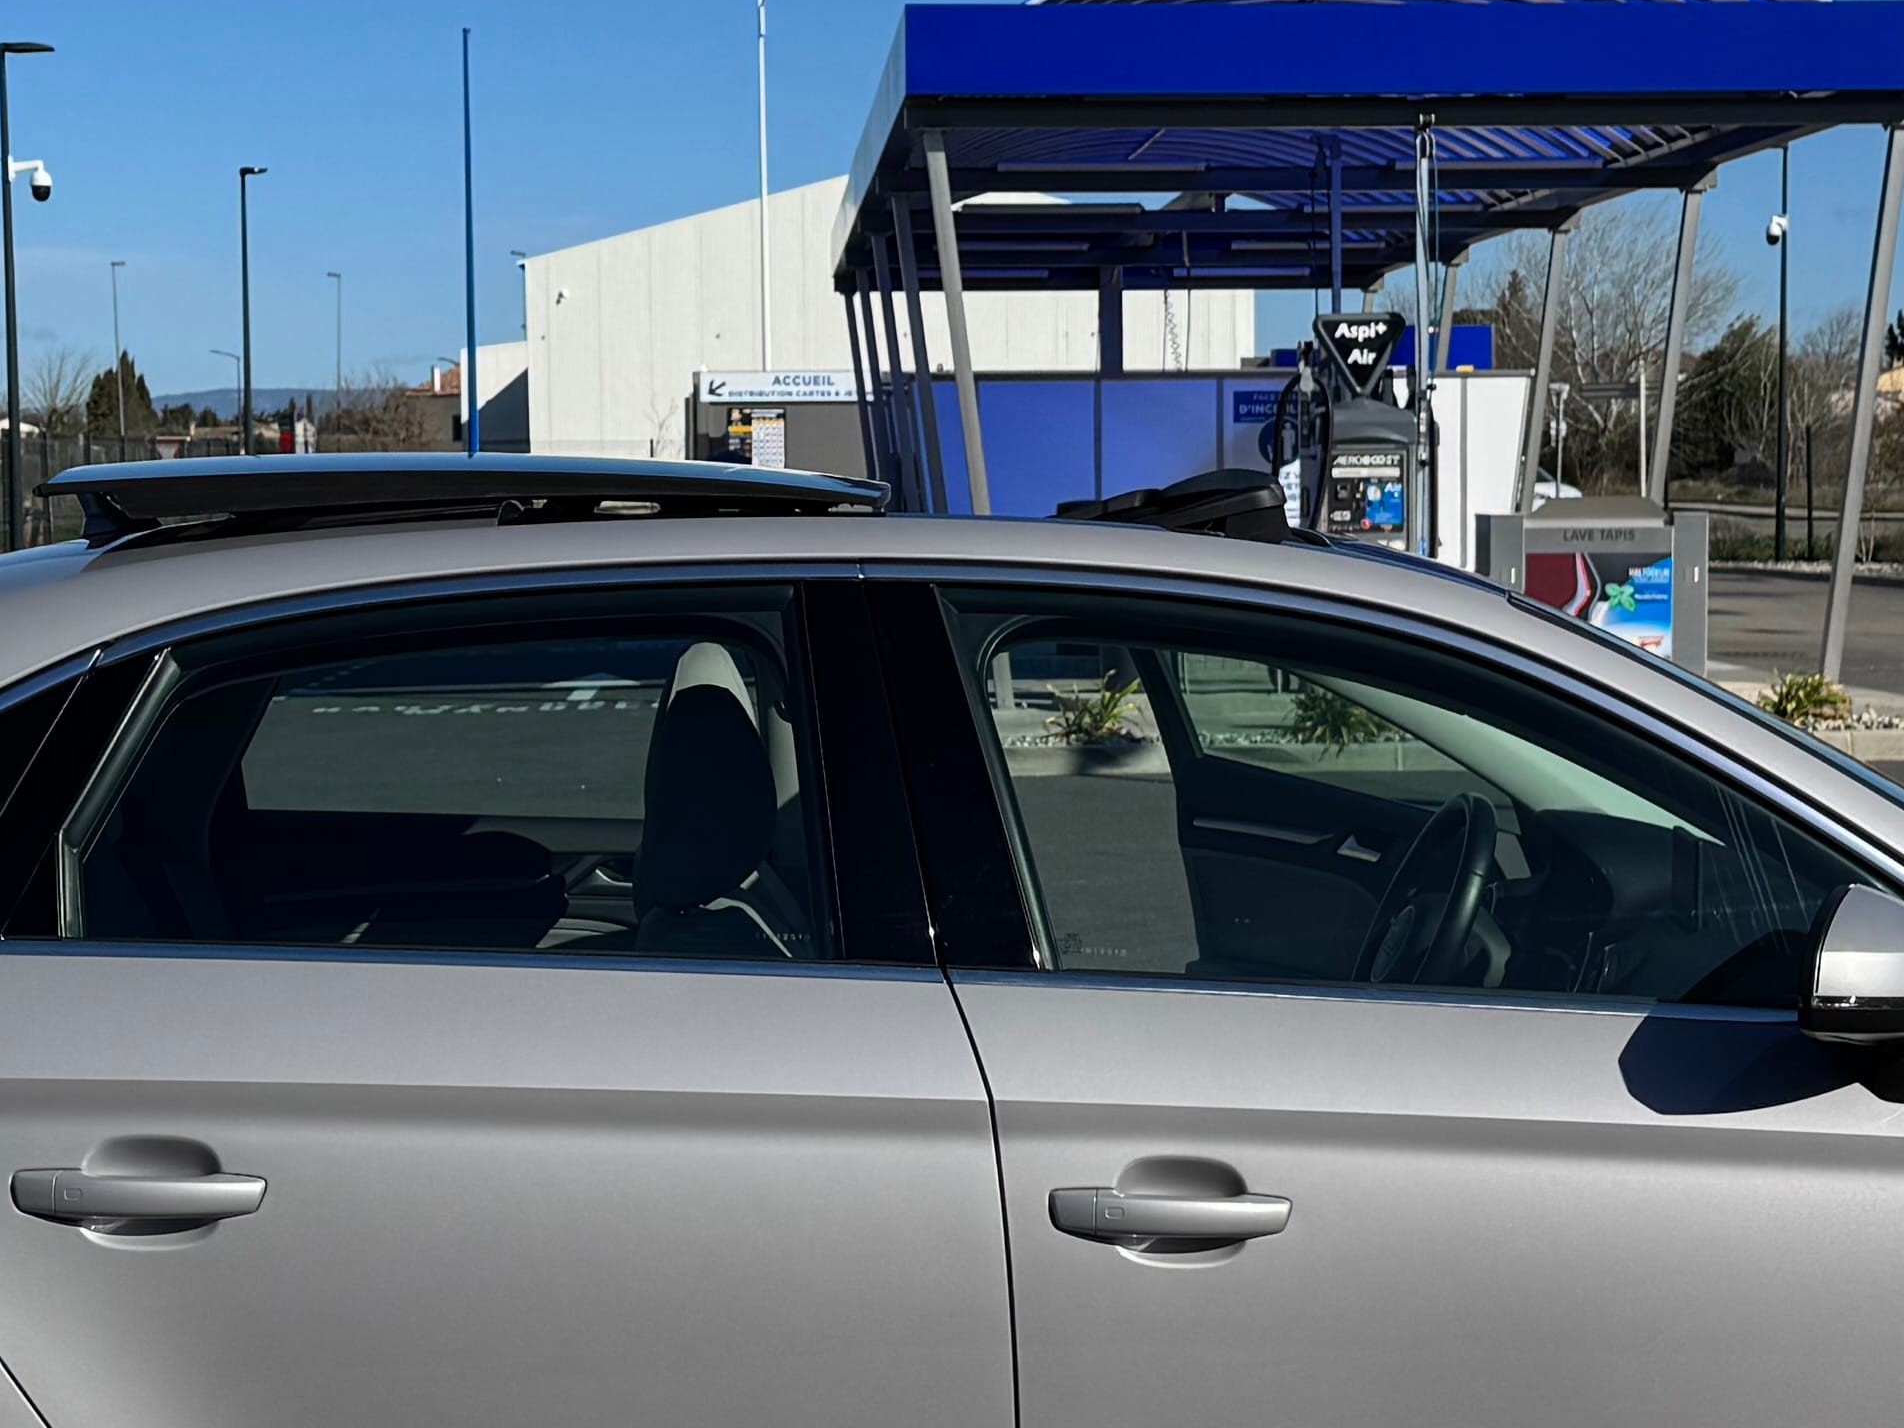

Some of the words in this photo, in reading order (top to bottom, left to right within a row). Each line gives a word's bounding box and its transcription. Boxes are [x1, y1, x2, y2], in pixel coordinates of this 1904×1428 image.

[1347, 348, 1376, 365] Air
[771, 375, 835, 387] ACCUEIL
[1563, 528, 1595, 542] LAVE
[1599, 528, 1636, 542] TAPIS
